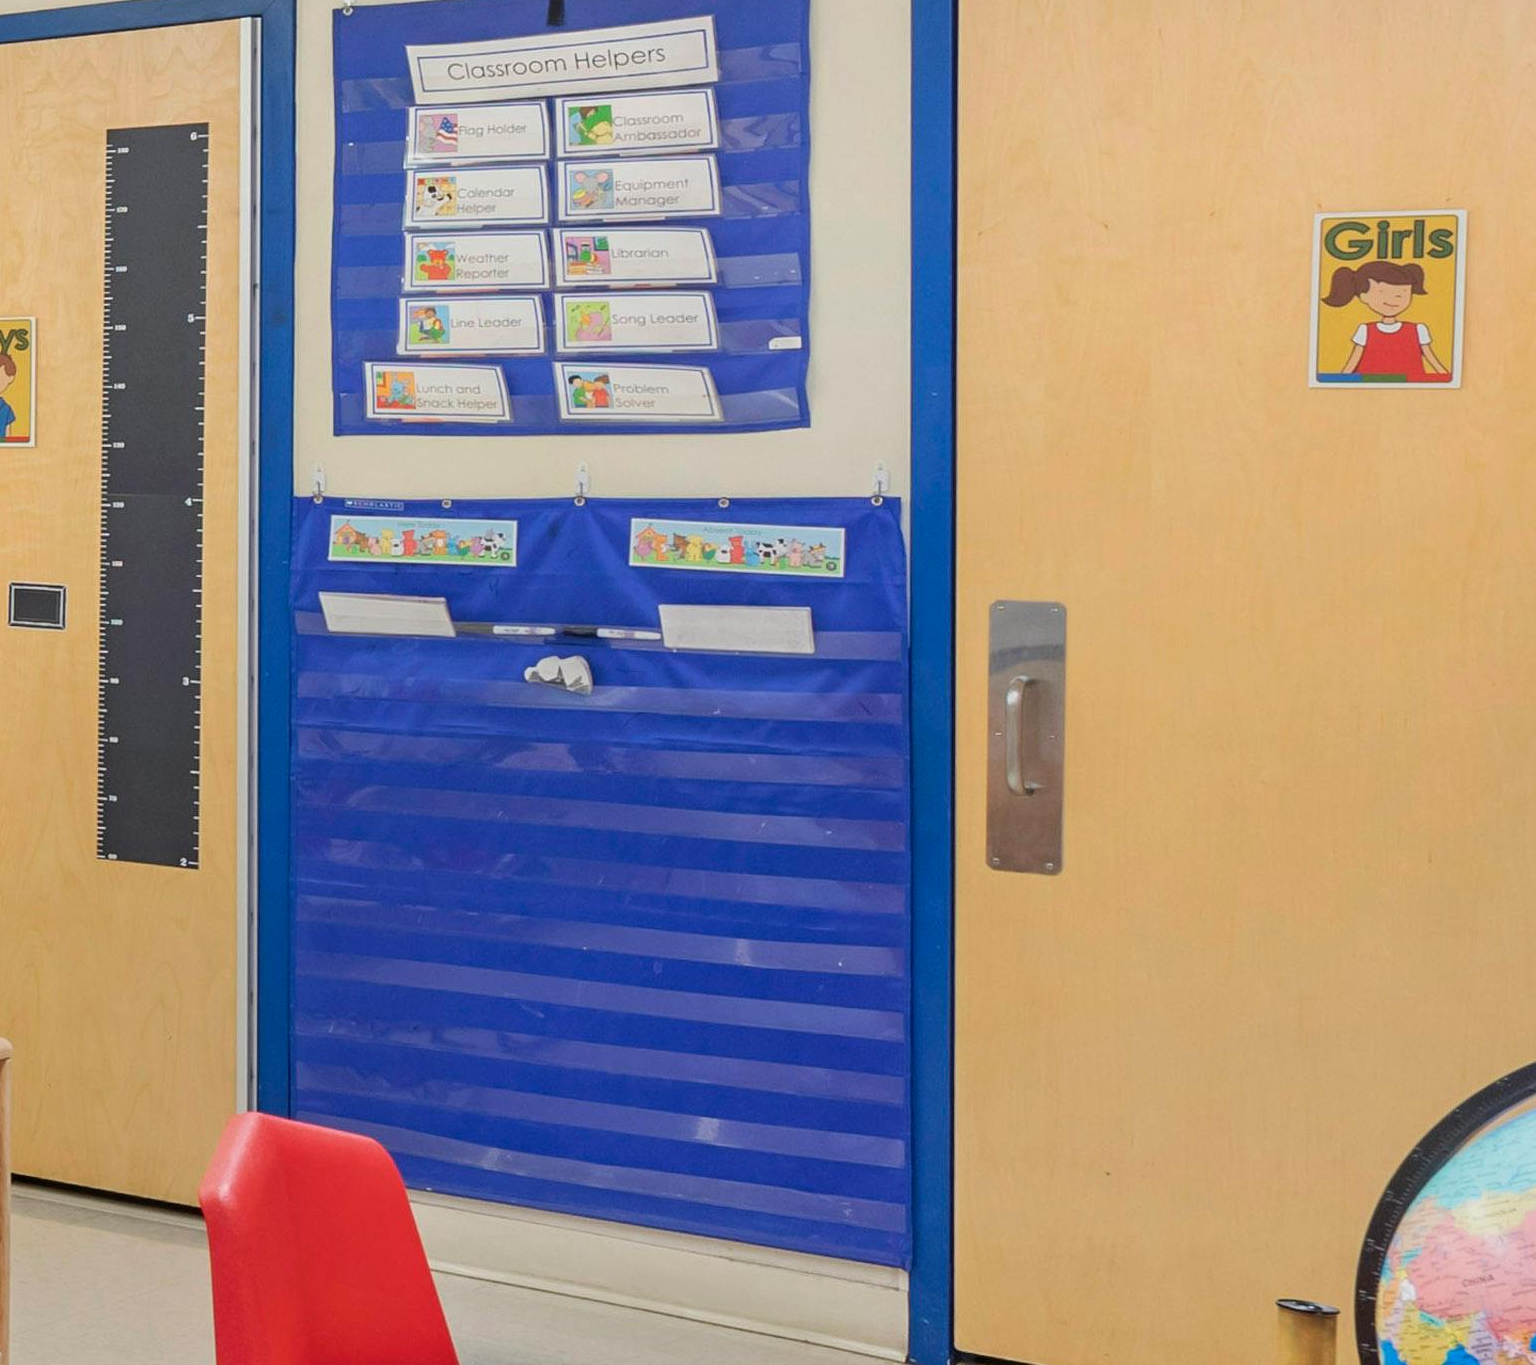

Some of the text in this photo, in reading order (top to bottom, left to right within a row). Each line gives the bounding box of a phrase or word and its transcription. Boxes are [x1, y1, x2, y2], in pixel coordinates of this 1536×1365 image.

[448, 46, 666, 81] Classroom Helpers
[613, 114, 684, 127] Classroom
[460, 124, 526, 137] Flag Holder
[614, 128, 701, 141] Ambassador
[615, 178, 689, 192] Equipment
[457, 187, 514, 200] Calendar
[615, 195, 680, 207] Manager
[457, 203, 496, 215] Helper
[1324, 219, 1455, 261] Girls
[456, 253, 510, 264] Weather
[611, 248, 669, 259] Librarian
[456, 268, 510, 280] Reporter
[452, 317, 522, 329] Line Leader
[613, 313, 698, 327] Song Leader
[417, 384, 481, 395] Lunch and
[613, 384, 669, 395] Problem
[417, 398, 498, 412] Snack Helper
[614, 398, 656, 409] Solver
[182, 677, 189, 685] 3
[180, 858, 187, 866] 2
[1462, 1273, 1495, 1287] CHINA
